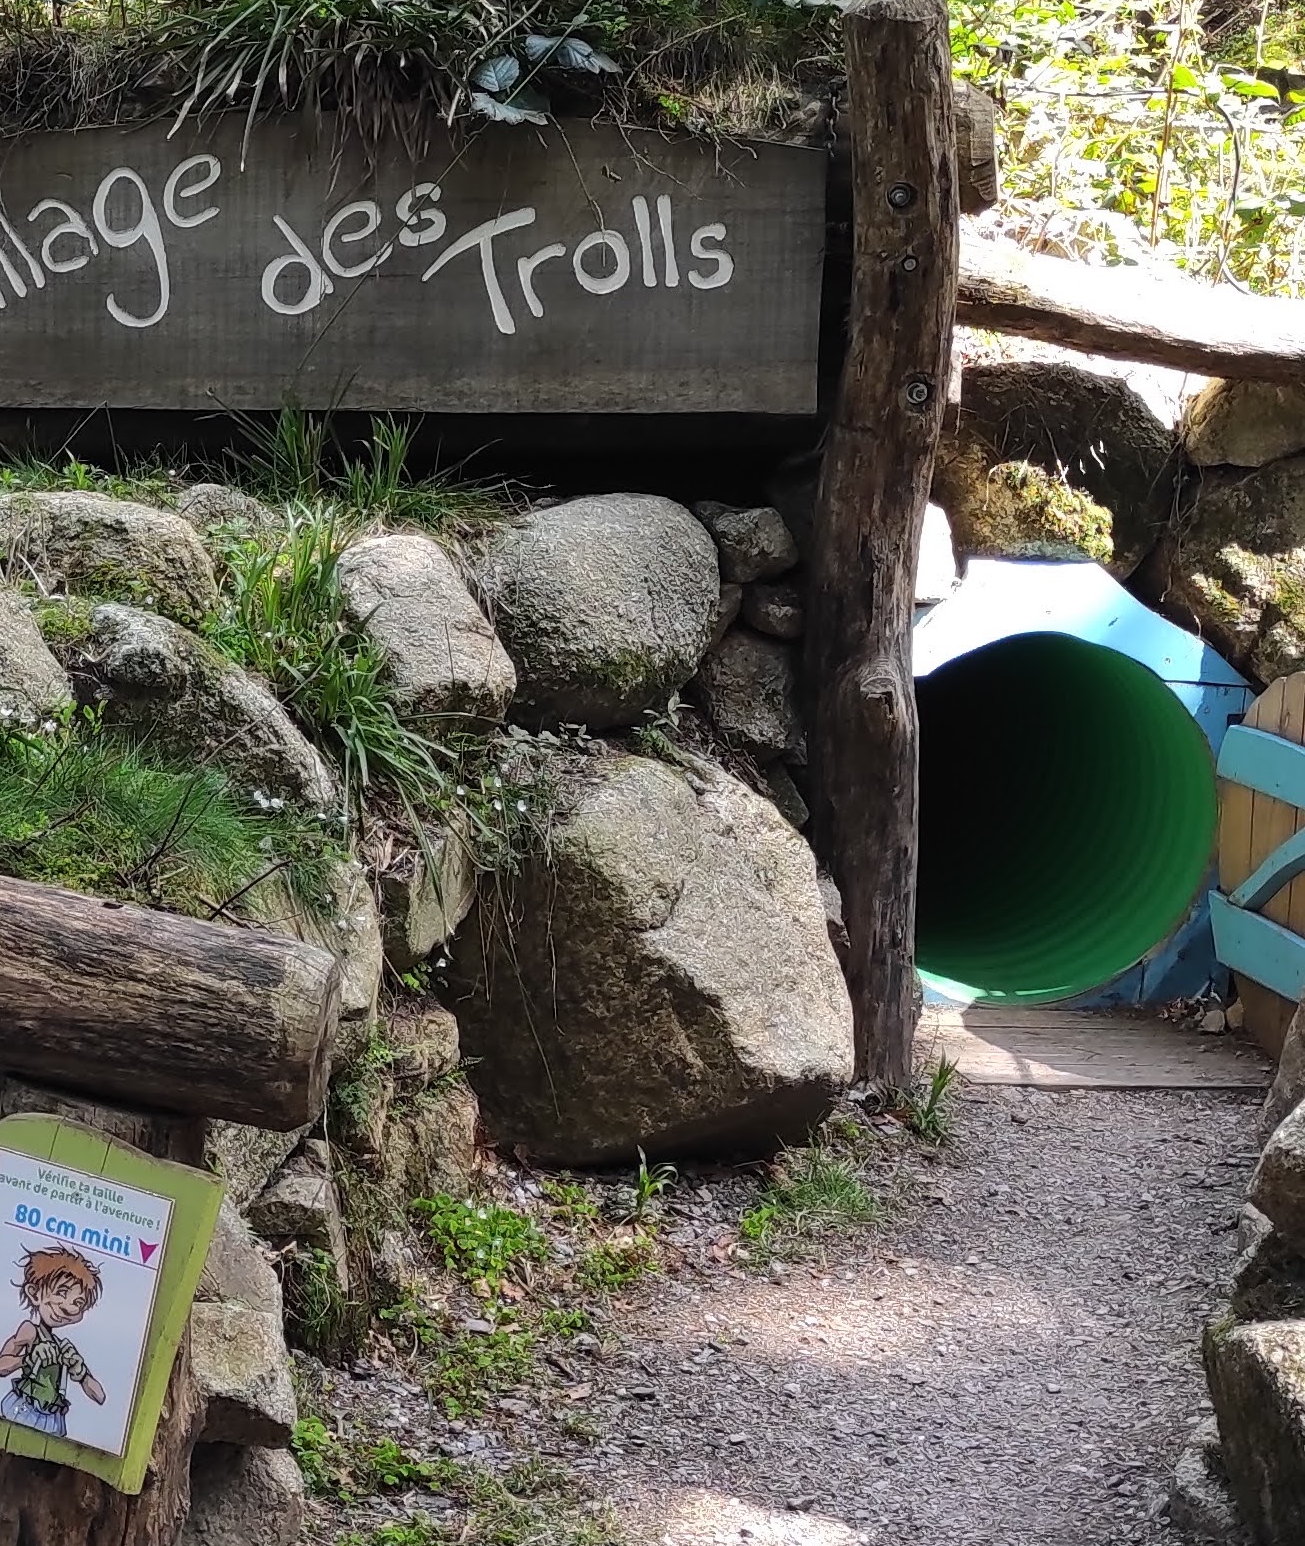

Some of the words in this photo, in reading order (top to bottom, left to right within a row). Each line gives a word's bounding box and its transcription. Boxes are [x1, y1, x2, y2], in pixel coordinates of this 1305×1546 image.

[260, 182, 446, 316] des
[421, 193, 735, 336] Trolls
[33, 1181, 48, 1195] de
[50, 1189, 84, 1206] partir
[85, 1196, 93, 1210] à
[95, 1199, 154, 1229] l'aventure
[38, 1167, 76, 1189] Vérifie
[79, 1181, 91, 1193] ta
[93, 1186, 124, 1204] taille
[14, 1204, 41, 1227] 80
[45, 1216, 76, 1239] cm
[81, 1227, 131, 1256] mini
